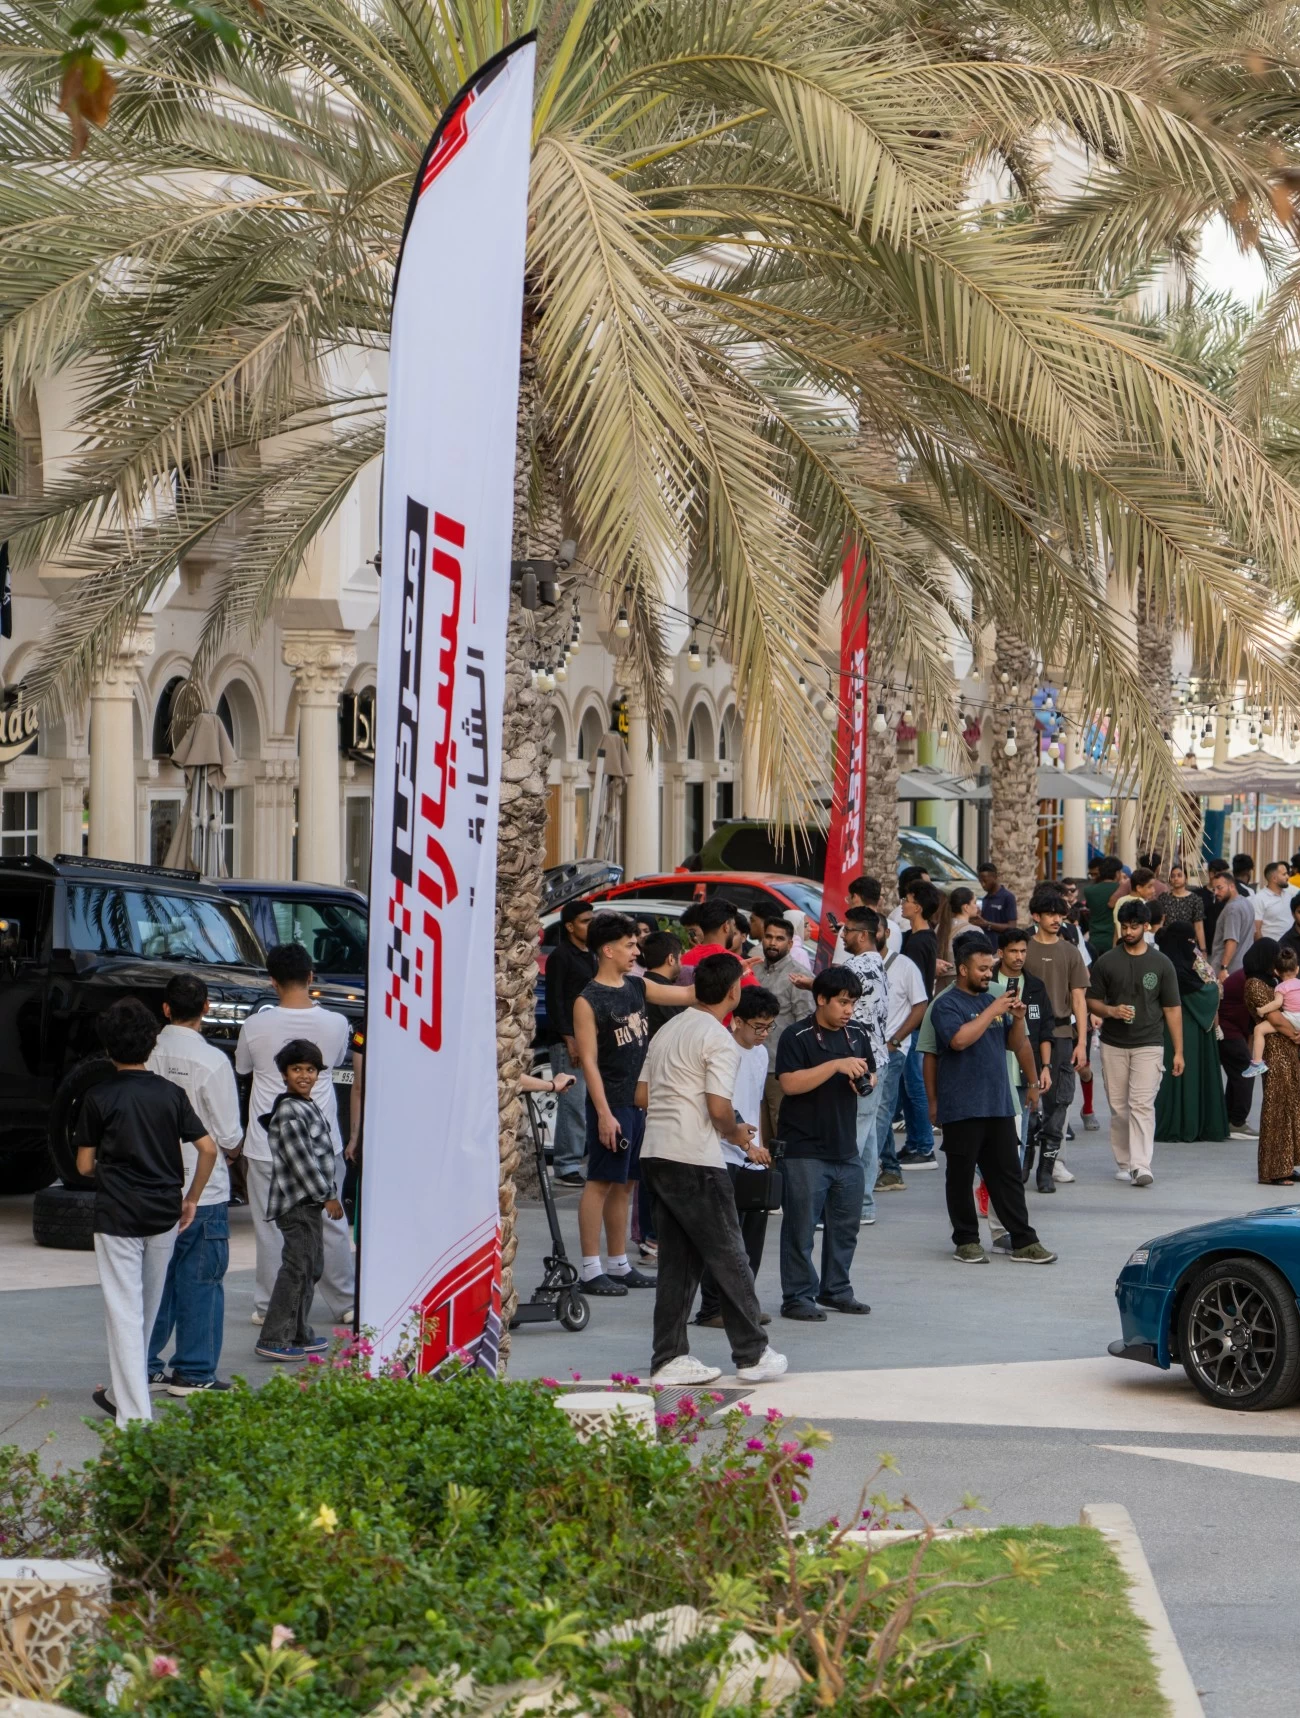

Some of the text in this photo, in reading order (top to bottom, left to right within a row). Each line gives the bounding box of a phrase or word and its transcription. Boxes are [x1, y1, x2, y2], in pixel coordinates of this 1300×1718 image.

[395, 528, 422, 855] معرض
[416, 510, 466, 1052] السيارات
[461, 646, 489, 907] الشارق
